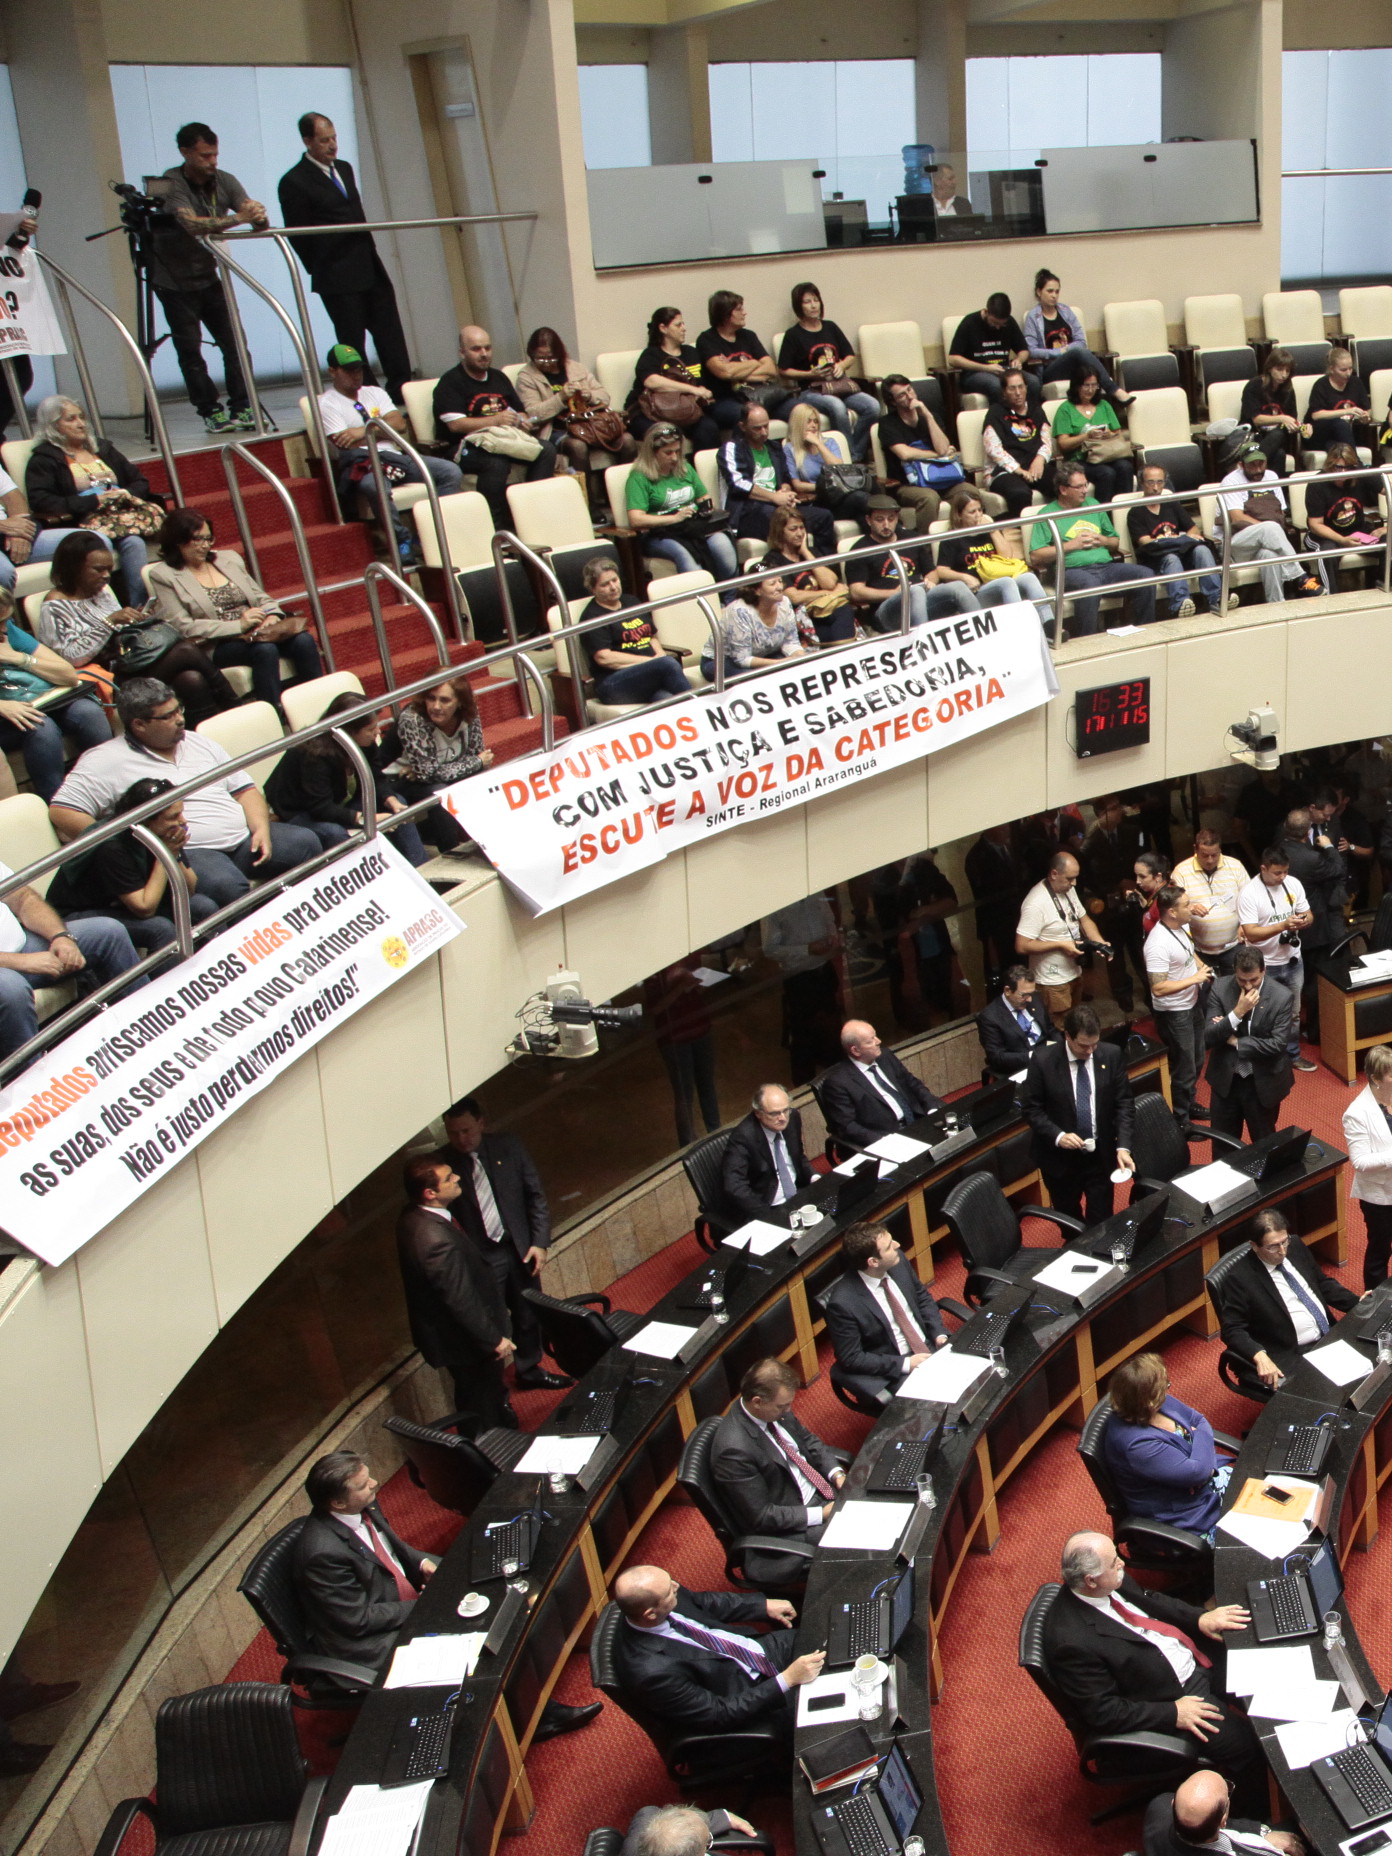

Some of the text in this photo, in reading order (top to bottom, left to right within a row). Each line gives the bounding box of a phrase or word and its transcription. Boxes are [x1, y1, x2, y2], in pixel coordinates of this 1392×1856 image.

[705, 691, 774, 732] NOS
[779, 610, 998, 708] REPRESENTEM
[1117, 682, 1144, 708] 33
[552, 656, 986, 828] COM JUSTIÇA E SABEDORIA,
[561, 799, 676, 875] ESCUTE
[685, 790, 706, 821] A
[717, 762, 777, 806] VOZ
[785, 746, 824, 783] DA
[706, 804, 745, 828] SINTE
[760, 784, 810, 811] Regional
[814, 756, 877, 791] Araranguá
[280, 899, 390, 985] Catarinense!
[403, 909, 444, 946] APRASC
[86, 997, 186, 1080] arriscamos
[177, 953, 247, 1010] nossas
[237, 921, 293, 965] vidas
[282, 901, 320, 935] pra
[312, 852, 391, 913] defender
[242, 976, 295, 1018] povo
[173, 1052, 197, 1070] e
[183, 1035, 218, 1062] de
[207, 1023, 295, 1109] perdermos
[129, 1060, 185, 1107] seus
[100, 1097, 143, 1137] dos
[155, 1122, 177, 1153] é
[165, 1093, 215, 1147] justo
[50, 1123, 112, 1176] suas,
[118, 1140, 165, 1183] Não
[20, 1163, 59, 1196] as
